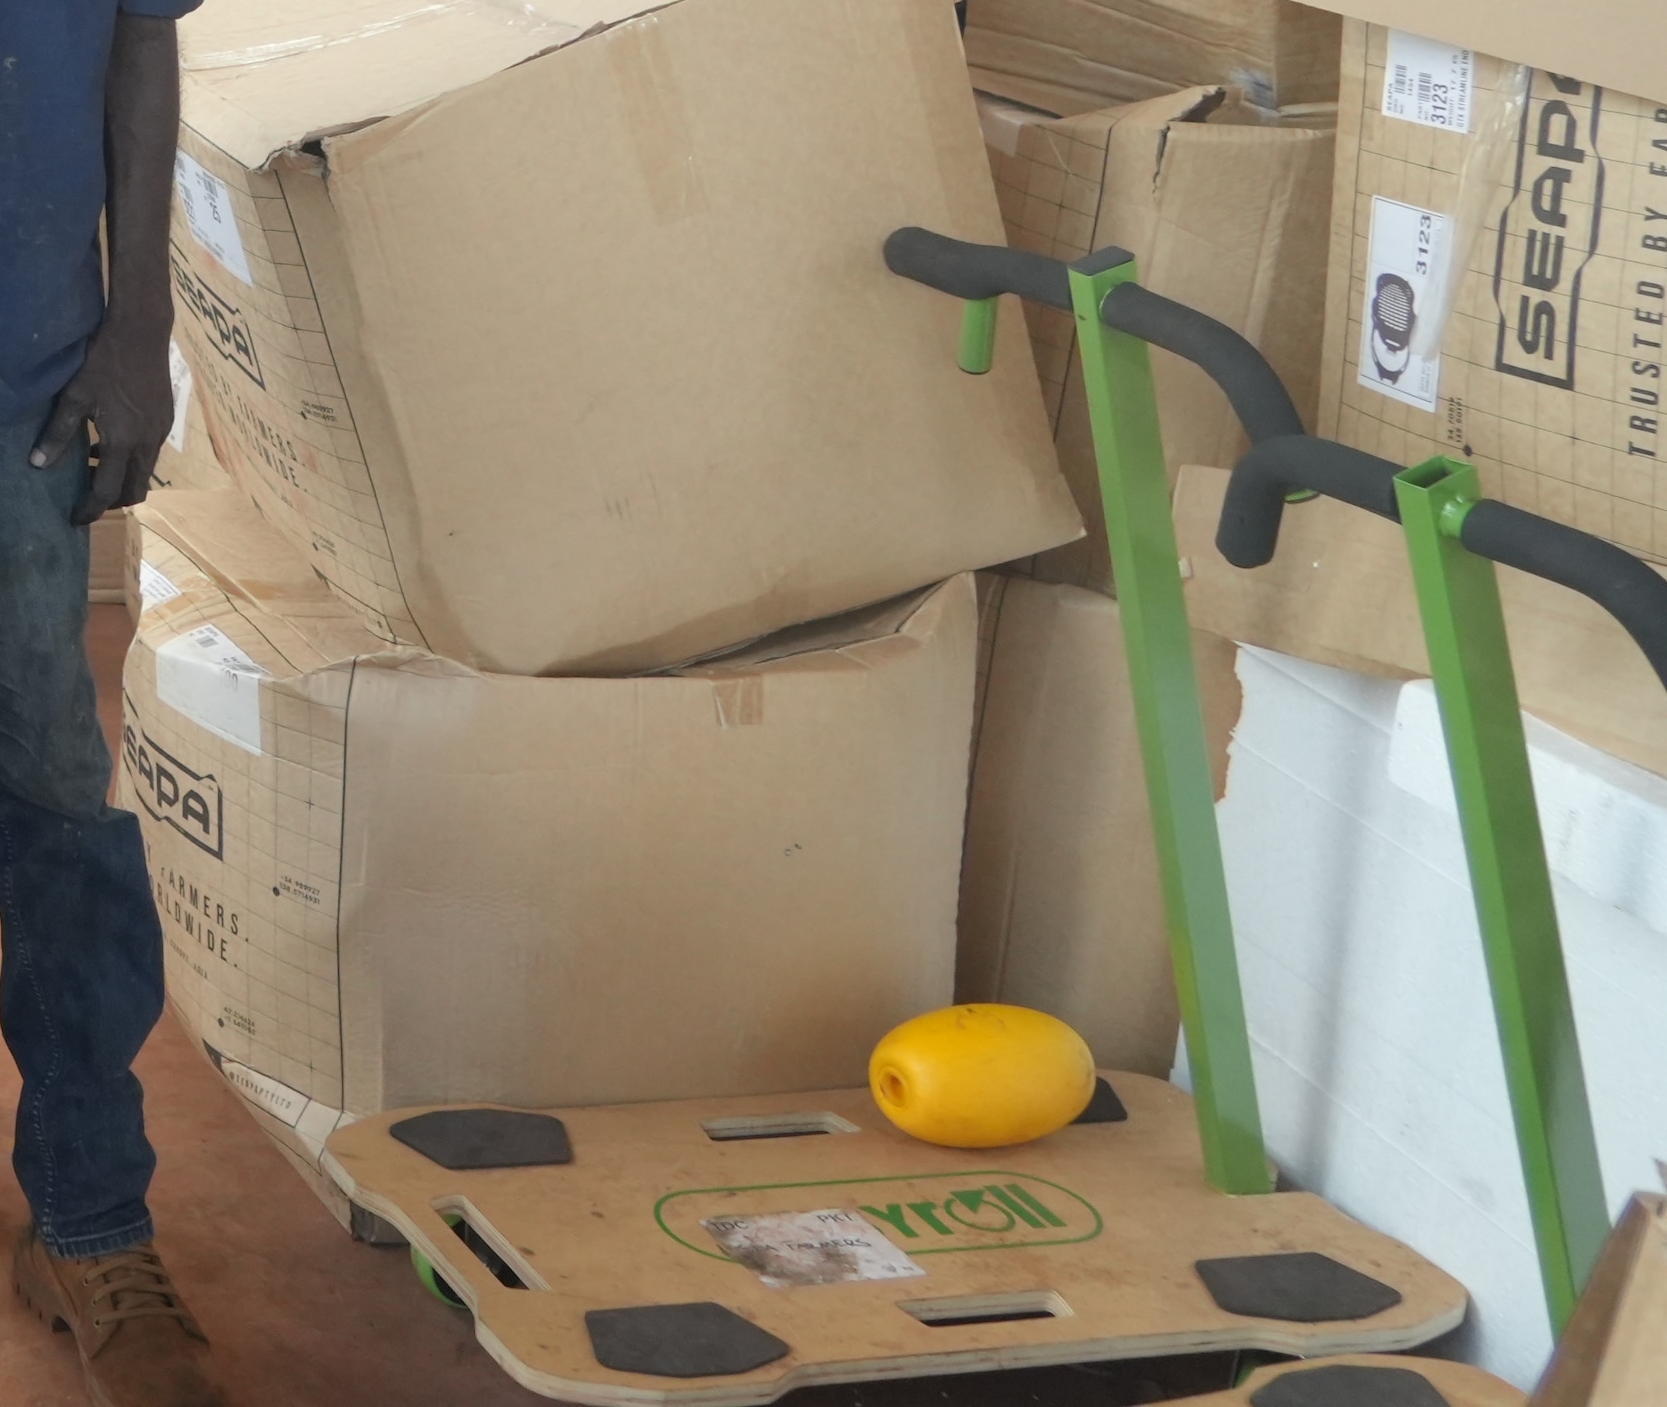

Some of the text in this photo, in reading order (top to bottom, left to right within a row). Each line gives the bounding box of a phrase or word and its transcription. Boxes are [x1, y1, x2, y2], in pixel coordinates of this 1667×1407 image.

[1386, 82, 1394, 112] SEAPA
[1430, 83, 1449, 125] 3123
[1416, 214, 1432, 275] 3123
[1641, 205, 1667, 252] BY
[171, 254, 253, 366] SEAPA
[1628, 279, 1665, 457] TRUSTED
[123, 713, 211, 835] EAPA
[151, 875, 238, 968] RLDWIDE.
[786, 1237, 872, 1252] FARMERS
